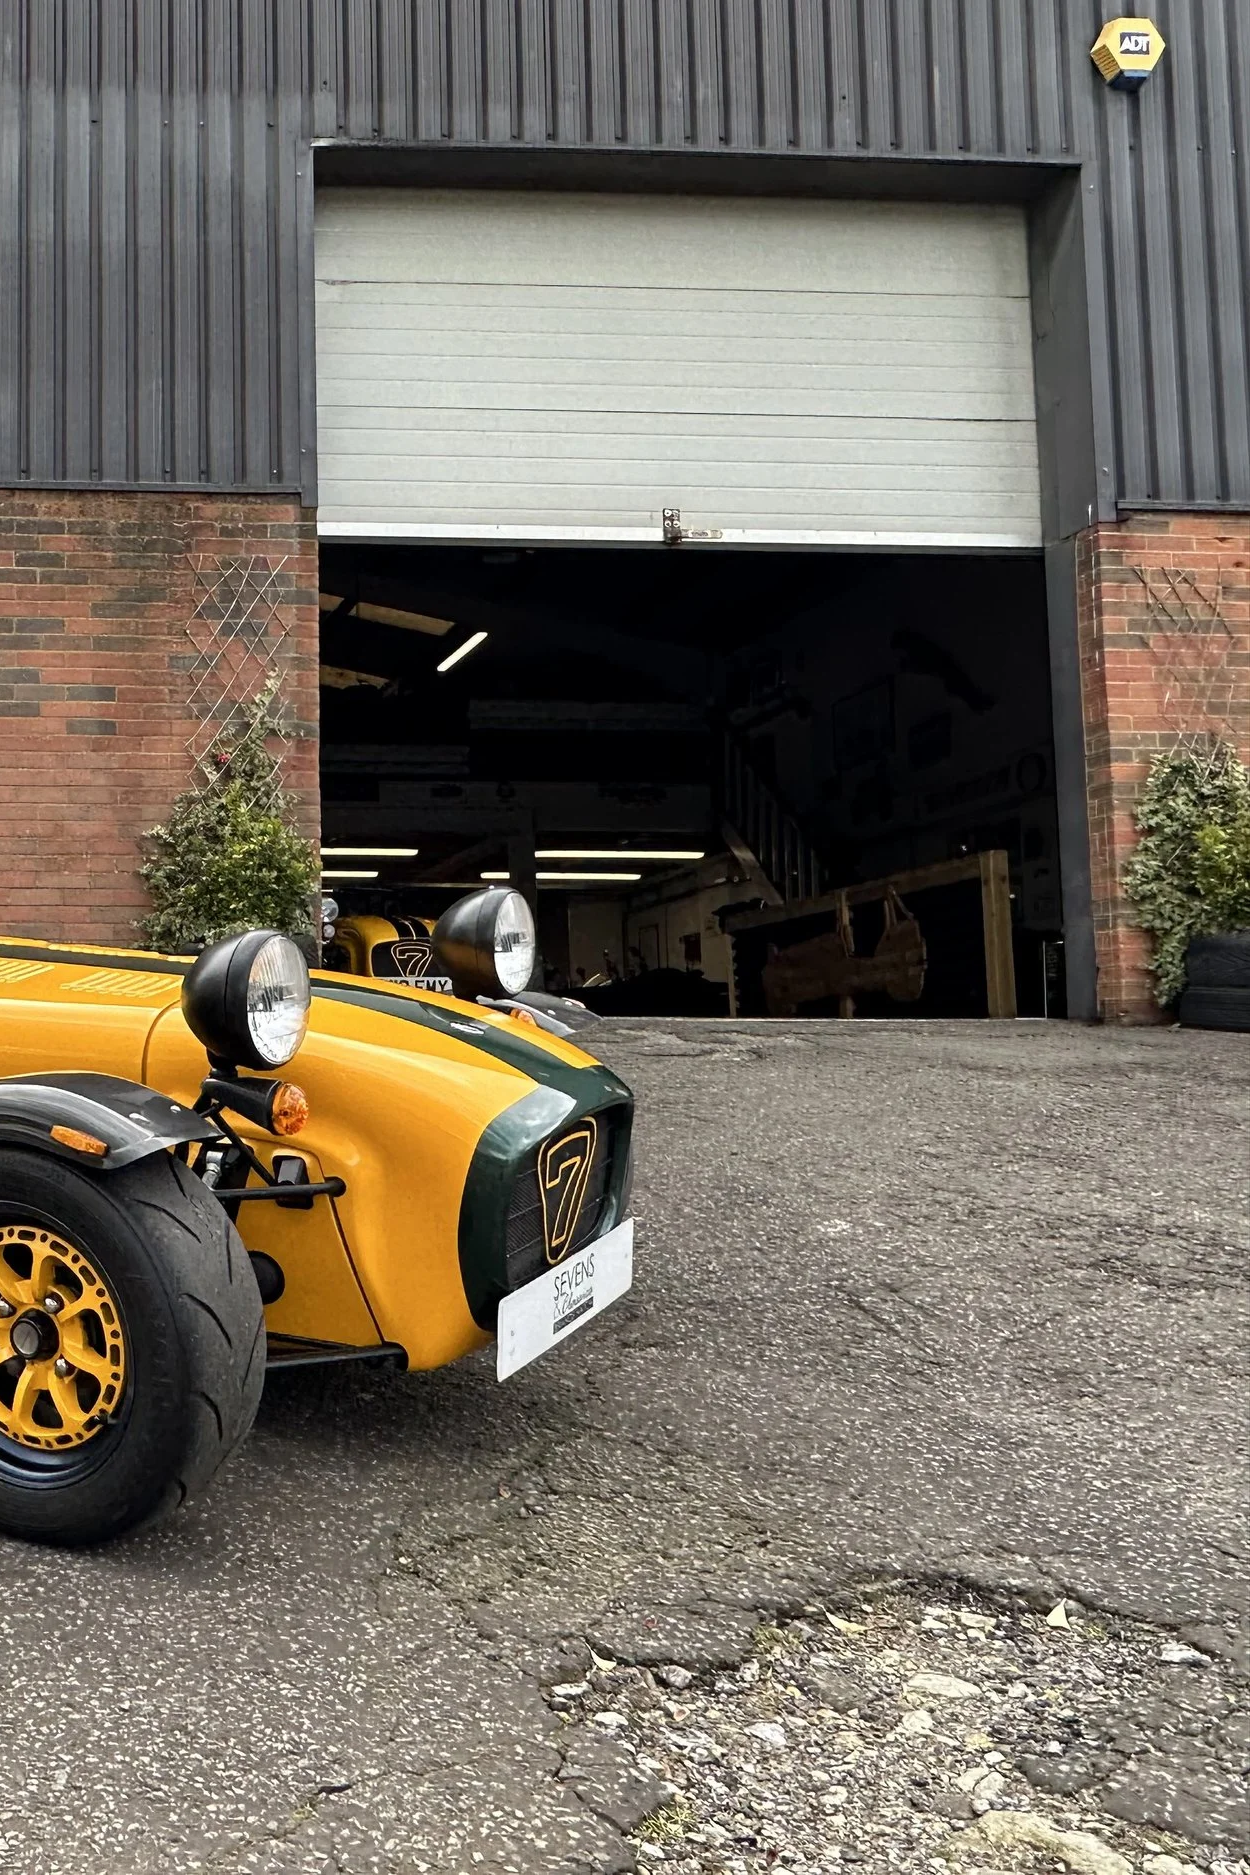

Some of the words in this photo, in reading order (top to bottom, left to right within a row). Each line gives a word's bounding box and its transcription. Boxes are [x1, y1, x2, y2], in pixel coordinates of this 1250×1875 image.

[1119, 35, 1150, 52] ADT
[546, 1130, 591, 1247] 7
[553, 1252, 595, 1302] SEVENS
